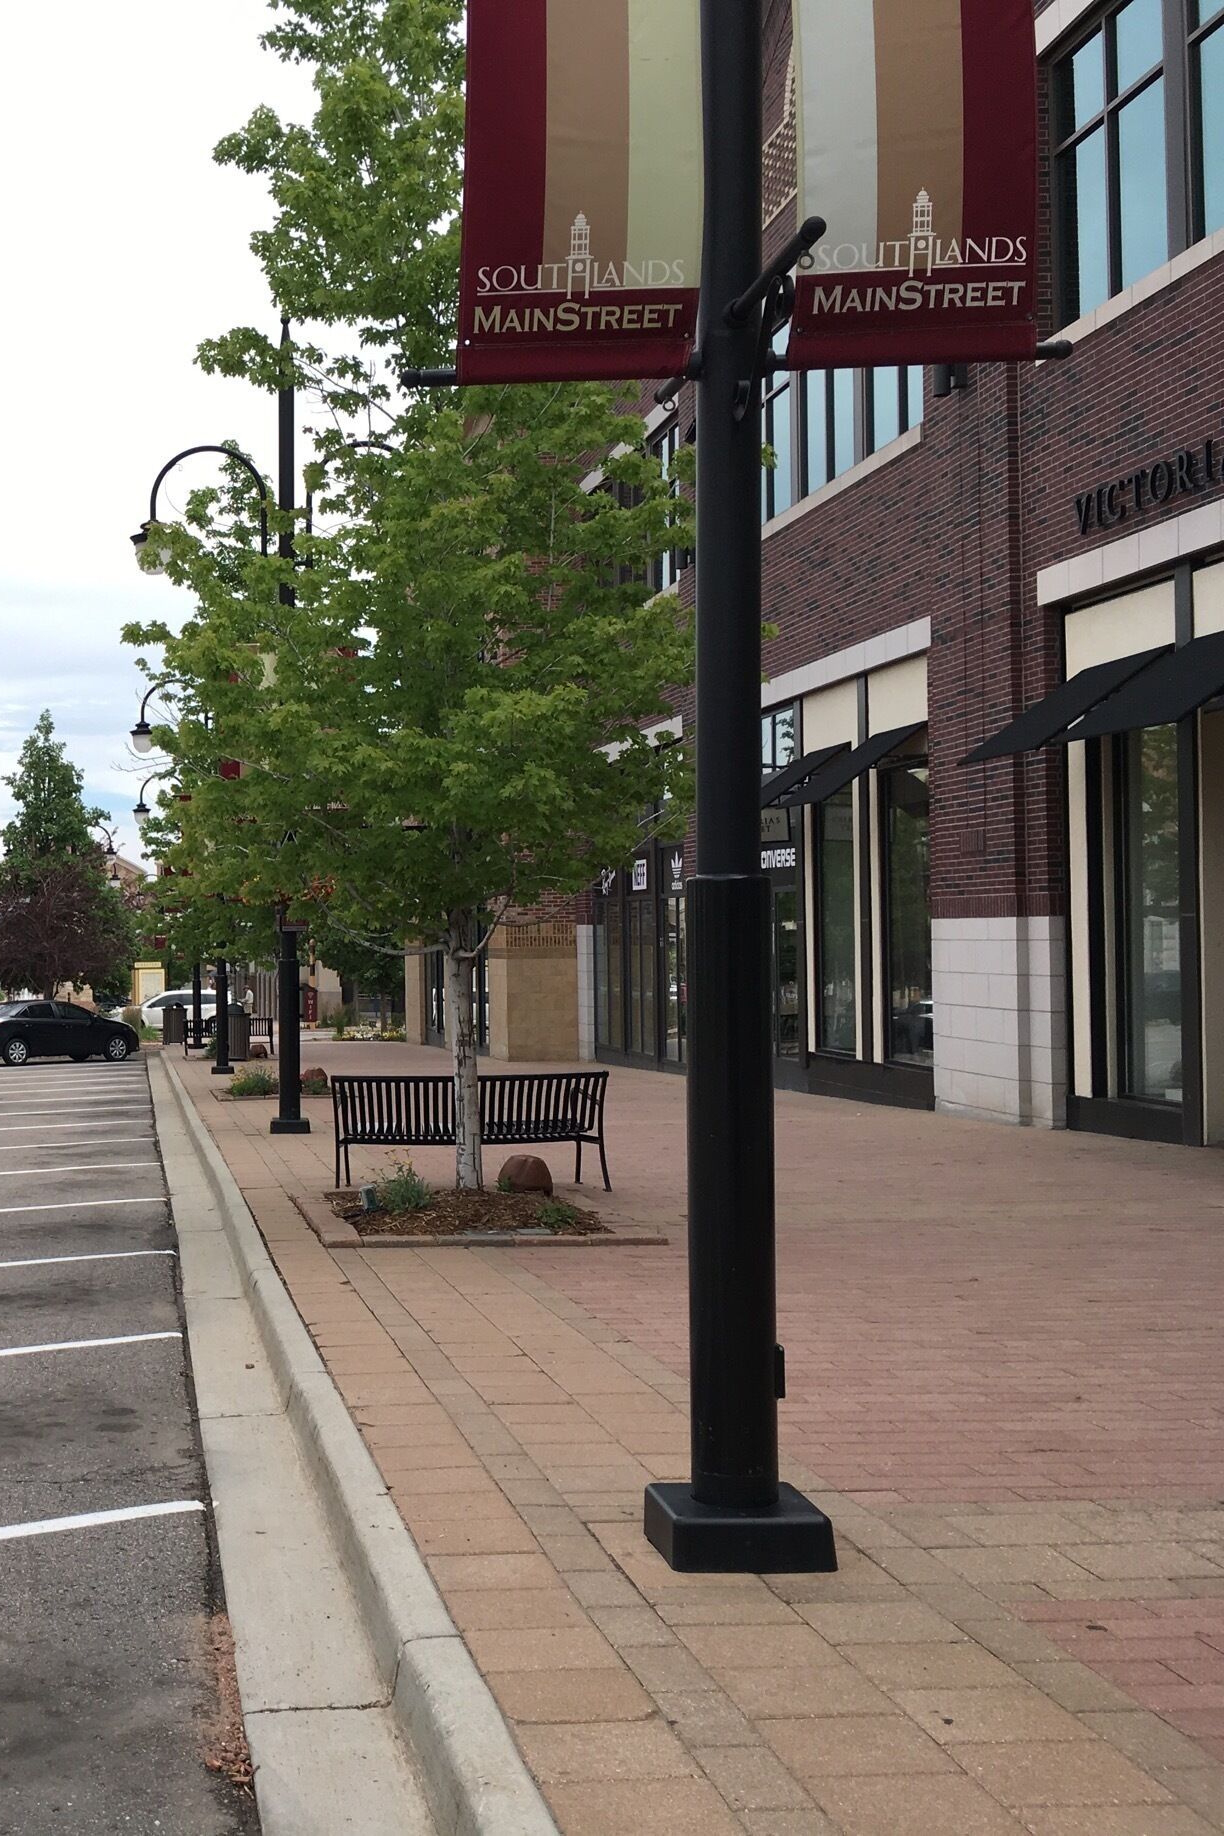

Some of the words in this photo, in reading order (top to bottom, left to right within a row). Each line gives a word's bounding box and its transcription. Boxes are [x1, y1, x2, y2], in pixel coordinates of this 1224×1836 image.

[817, 236, 1027, 277] SOUTHLANDS
[477, 257, 684, 299] SOUTHLANDS
[1076, 439, 1224, 535] VICTORI
[761, 847, 796, 869] ONVERSE
